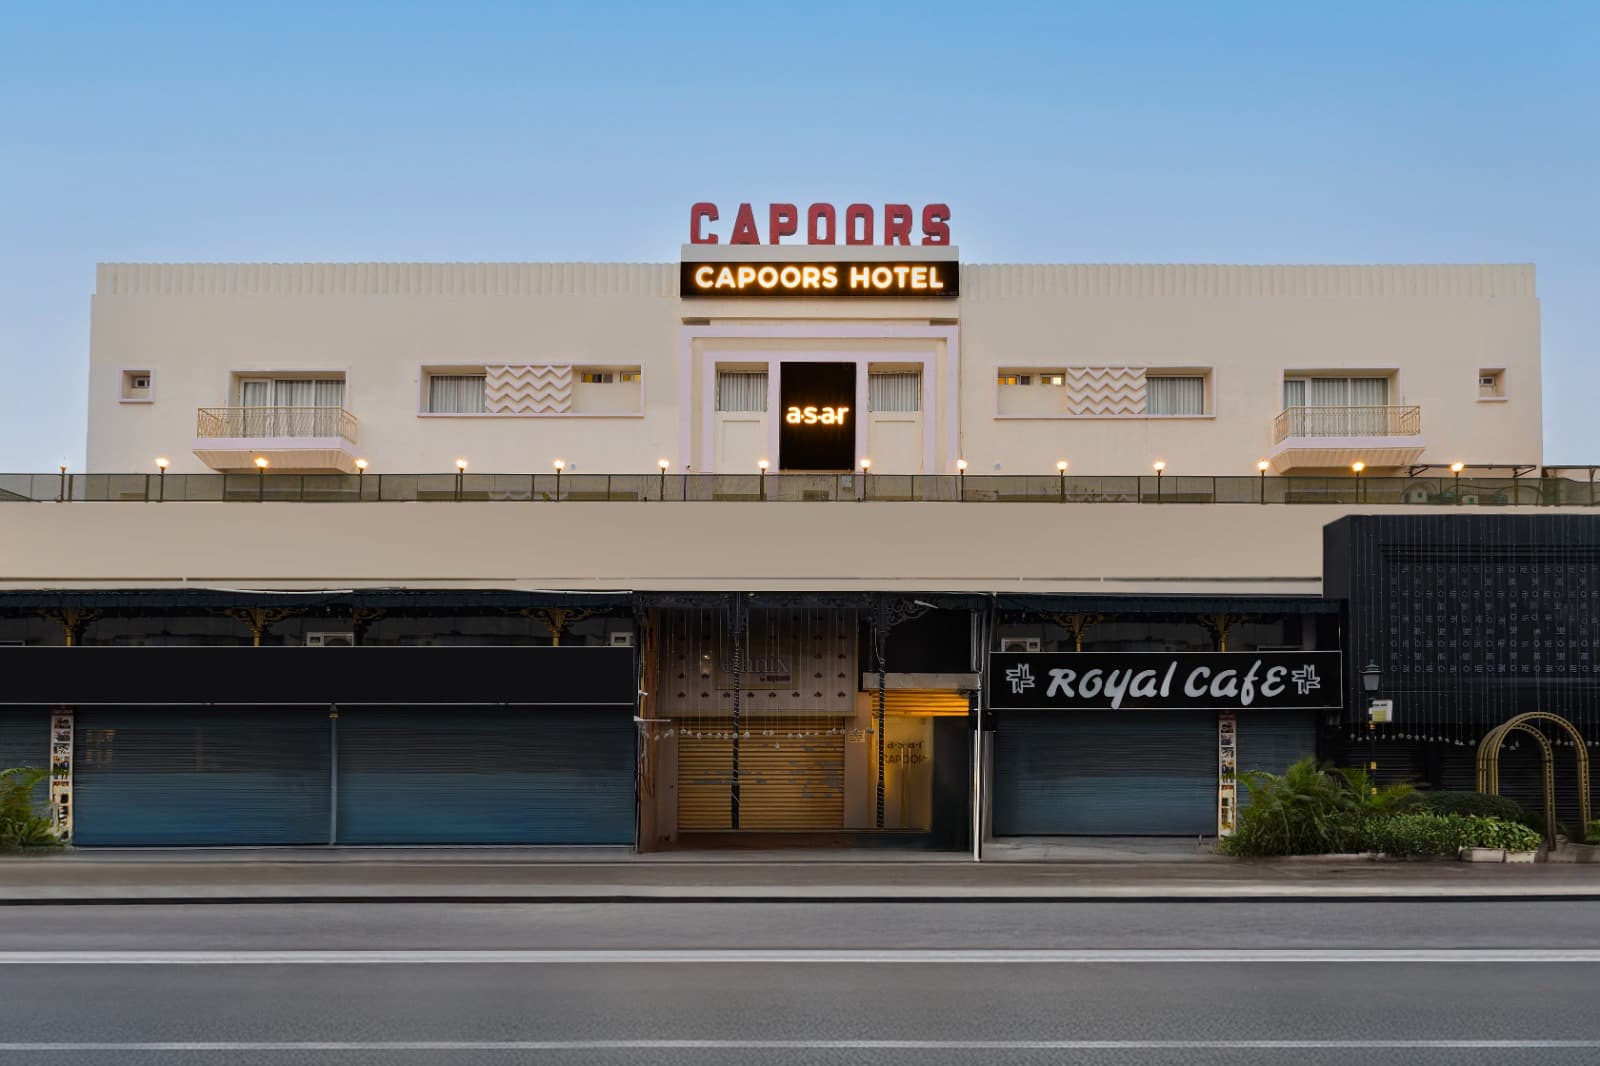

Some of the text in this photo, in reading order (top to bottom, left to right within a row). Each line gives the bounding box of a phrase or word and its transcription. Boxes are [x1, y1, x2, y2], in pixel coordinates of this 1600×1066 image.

[690, 202, 951, 245] CAPOORS
[694, 267, 944, 289] CAPOORS HOTEL
[1047, 661, 1177, 709] Royal
